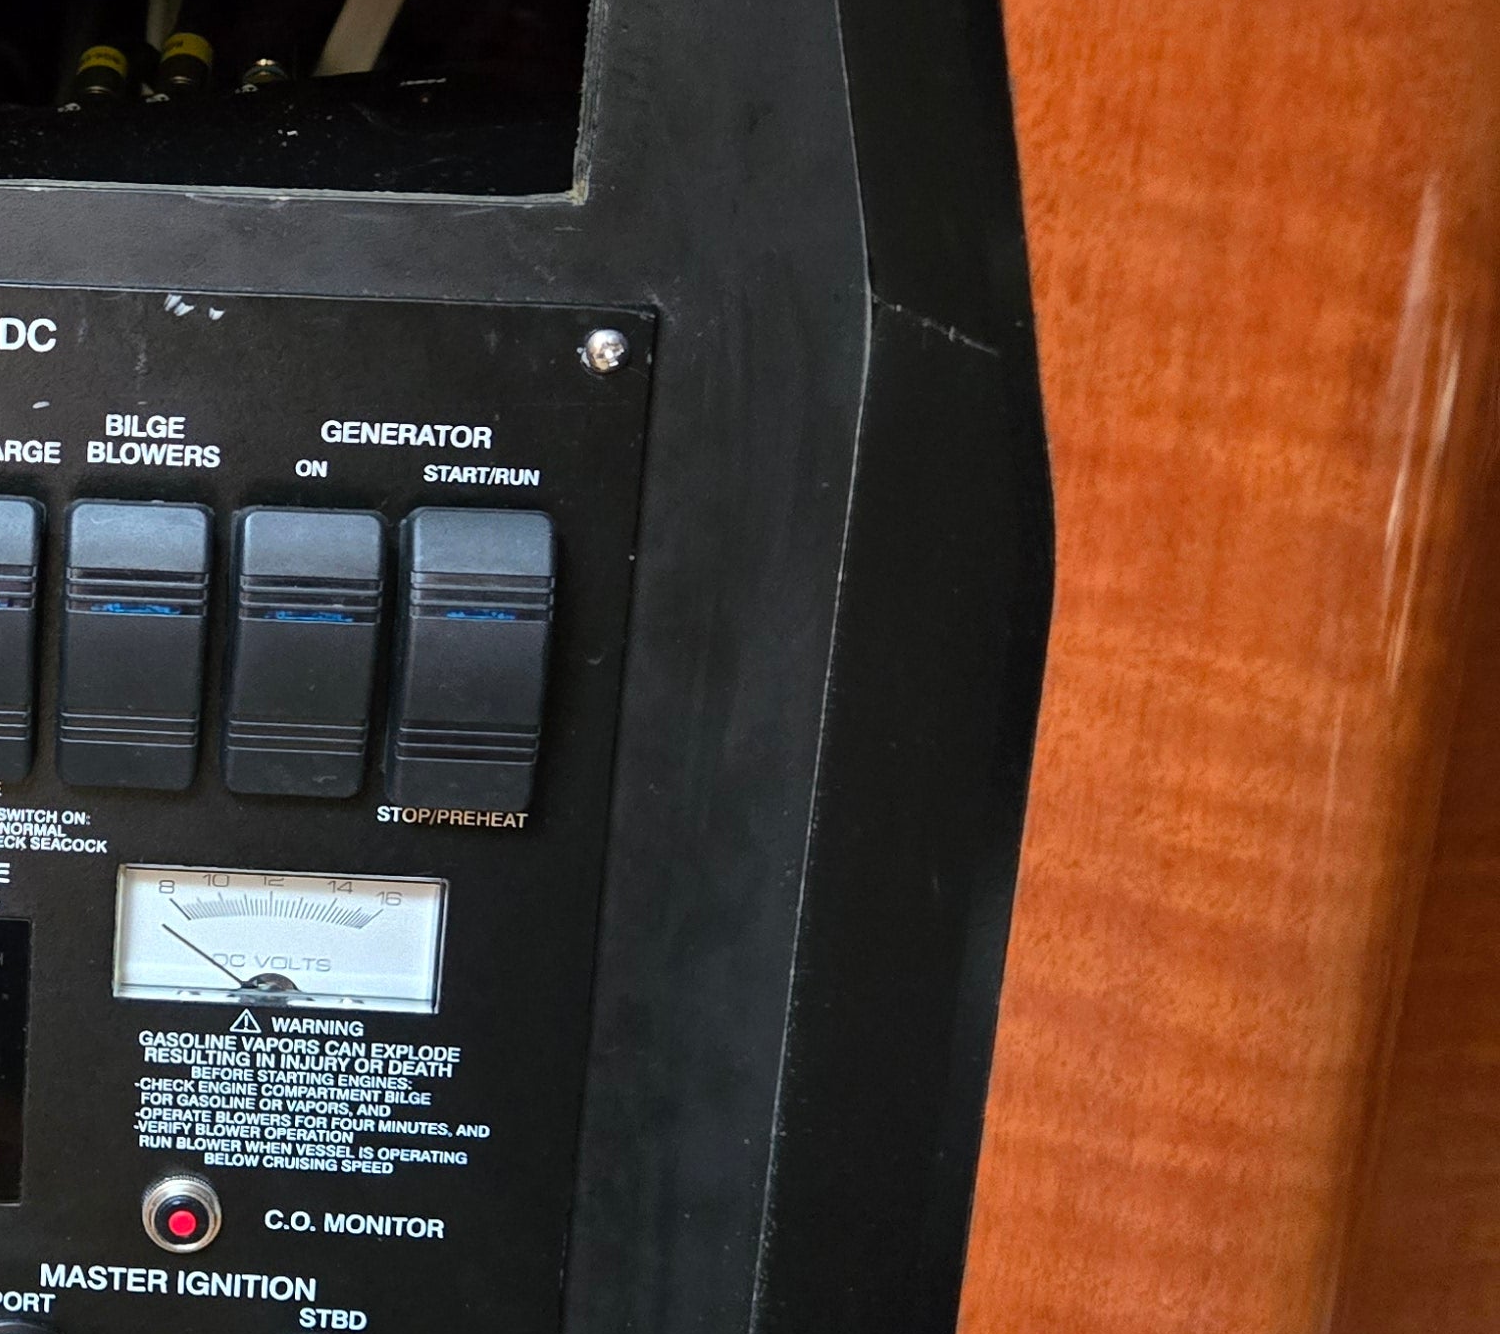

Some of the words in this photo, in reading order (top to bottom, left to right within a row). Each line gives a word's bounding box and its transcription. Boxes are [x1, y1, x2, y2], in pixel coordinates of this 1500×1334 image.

[0, 318, 57, 352] DC
[105, 414, 186, 439] BILGE
[321, 419, 492, 449] GENERATOR
[87, 441, 221, 467] BLOWERS
[296, 459, 328, 478] ON
[423, 464, 539, 486] START/RUN
[62, 811, 91, 825] ON:
[376, 805, 529, 829] STOP/PREHEAT
[30, 838, 108, 854] SEACOCK
[158, 879, 175, 894] 8
[203, 873, 230, 888] 10
[328, 880, 353, 895] 14
[380, 891, 403, 906] 16
[213, 952, 245, 968] DC
[255, 955, 332, 972] VOLTS
[271, 1017, 364, 1037] WARNING
[138, 1030, 237, 1051] GASOLINE
[242, 1037, 319, 1055] VAPORS
[324, 1040, 366, 1058] CAN
[371, 1043, 461, 1063] EXPLODE
[144, 1047, 250, 1067] RESULTING
[255, 1052, 274, 1068] IN
[280, 1055, 350, 1074] INJURY
[354, 1058, 383, 1075] OR
[388, 1060, 452, 1078] DEATH
[191, 1066, 254, 1082] BEFORE
[258, 1069, 334, 1087] STARTING
[338, 1074, 413, 1090] ENGINES:
[141, 1092, 173, 1107] FOR
[176, 1094, 256, 1110] GASOLINE
[259, 1098, 283, 1112] OR
[286, 1100, 352, 1117] VAPORS,
[358, 1103, 391, 1117] AND
[199, 1081, 258, 1096] ENGINE
[261, 1084, 381, 1103] COMPARTMENT
[385, 1090, 432, 1106] BILGE
[195, 1123, 261, 1139] BLOWER
[264, 1127, 354, 1144] OPERATION
[215, 1110, 292, 1127] BLOWERS
[295, 1114, 327, 1129] FOR
[331, 1116, 375, 1132] FOUR
[378, 1119, 452, 1137] MINUTES,
[456, 1123, 491, 1138] AND
[139, 1135, 172, 1149] RUN
[176, 1137, 242, 1153] BLOWER
[245, 1140, 292, 1156] WHEN
[296, 1144, 355, 1159] VESSEL
[377, 1147, 468, 1165] OPERATING
[204, 1152, 260, 1167] BELOW
[262, 1154, 338, 1171] CRUISING
[341, 1160, 394, 1175] SPEED
[264, 1209, 316, 1232] C.O.
[324, 1213, 444, 1239] MONITOR
[39, 1263, 168, 1295] MASTER
[177, 1270, 316, 1302] IGNITION
[299, 1307, 368, 1331] STBD
